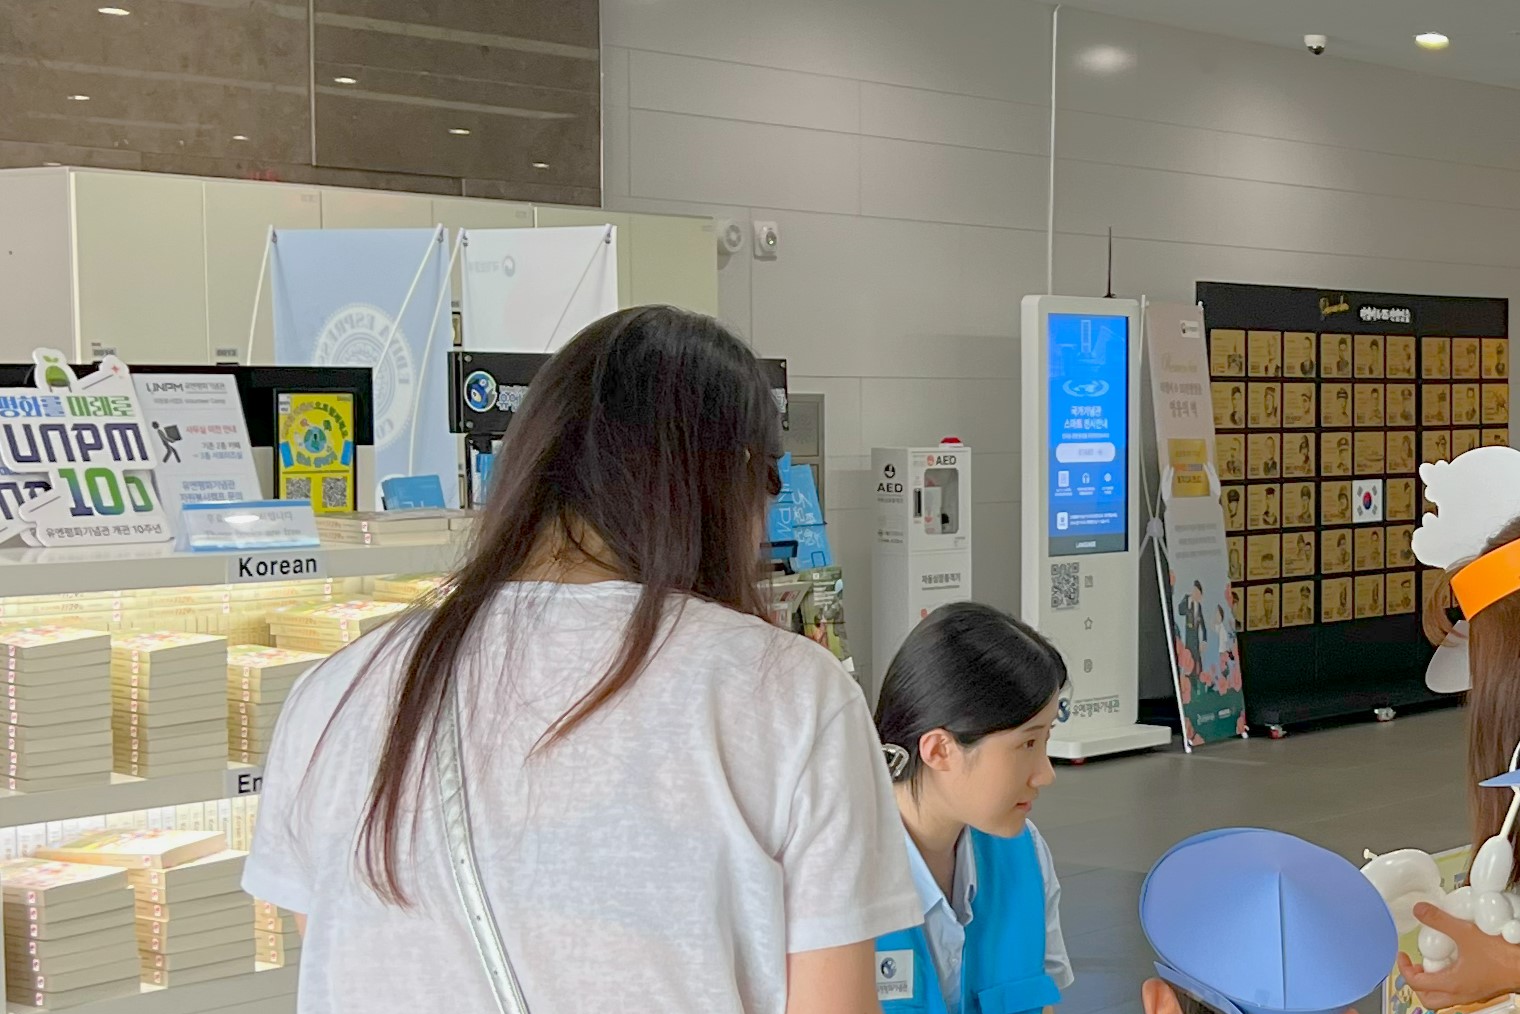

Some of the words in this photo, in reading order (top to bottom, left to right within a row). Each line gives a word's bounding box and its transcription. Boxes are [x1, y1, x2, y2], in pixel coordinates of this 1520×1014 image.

[66, 395, 136, 418] 미래로
[3, 423, 148, 463] UNPM
[935, 455, 957, 466] AED
[877, 482, 904, 493] AED
[46, 526, 110, 539] 유엔평화기념관
[113, 525, 131, 536] 개관
[133, 523, 162, 535] 10주년
[238, 556, 318, 578] Korean
